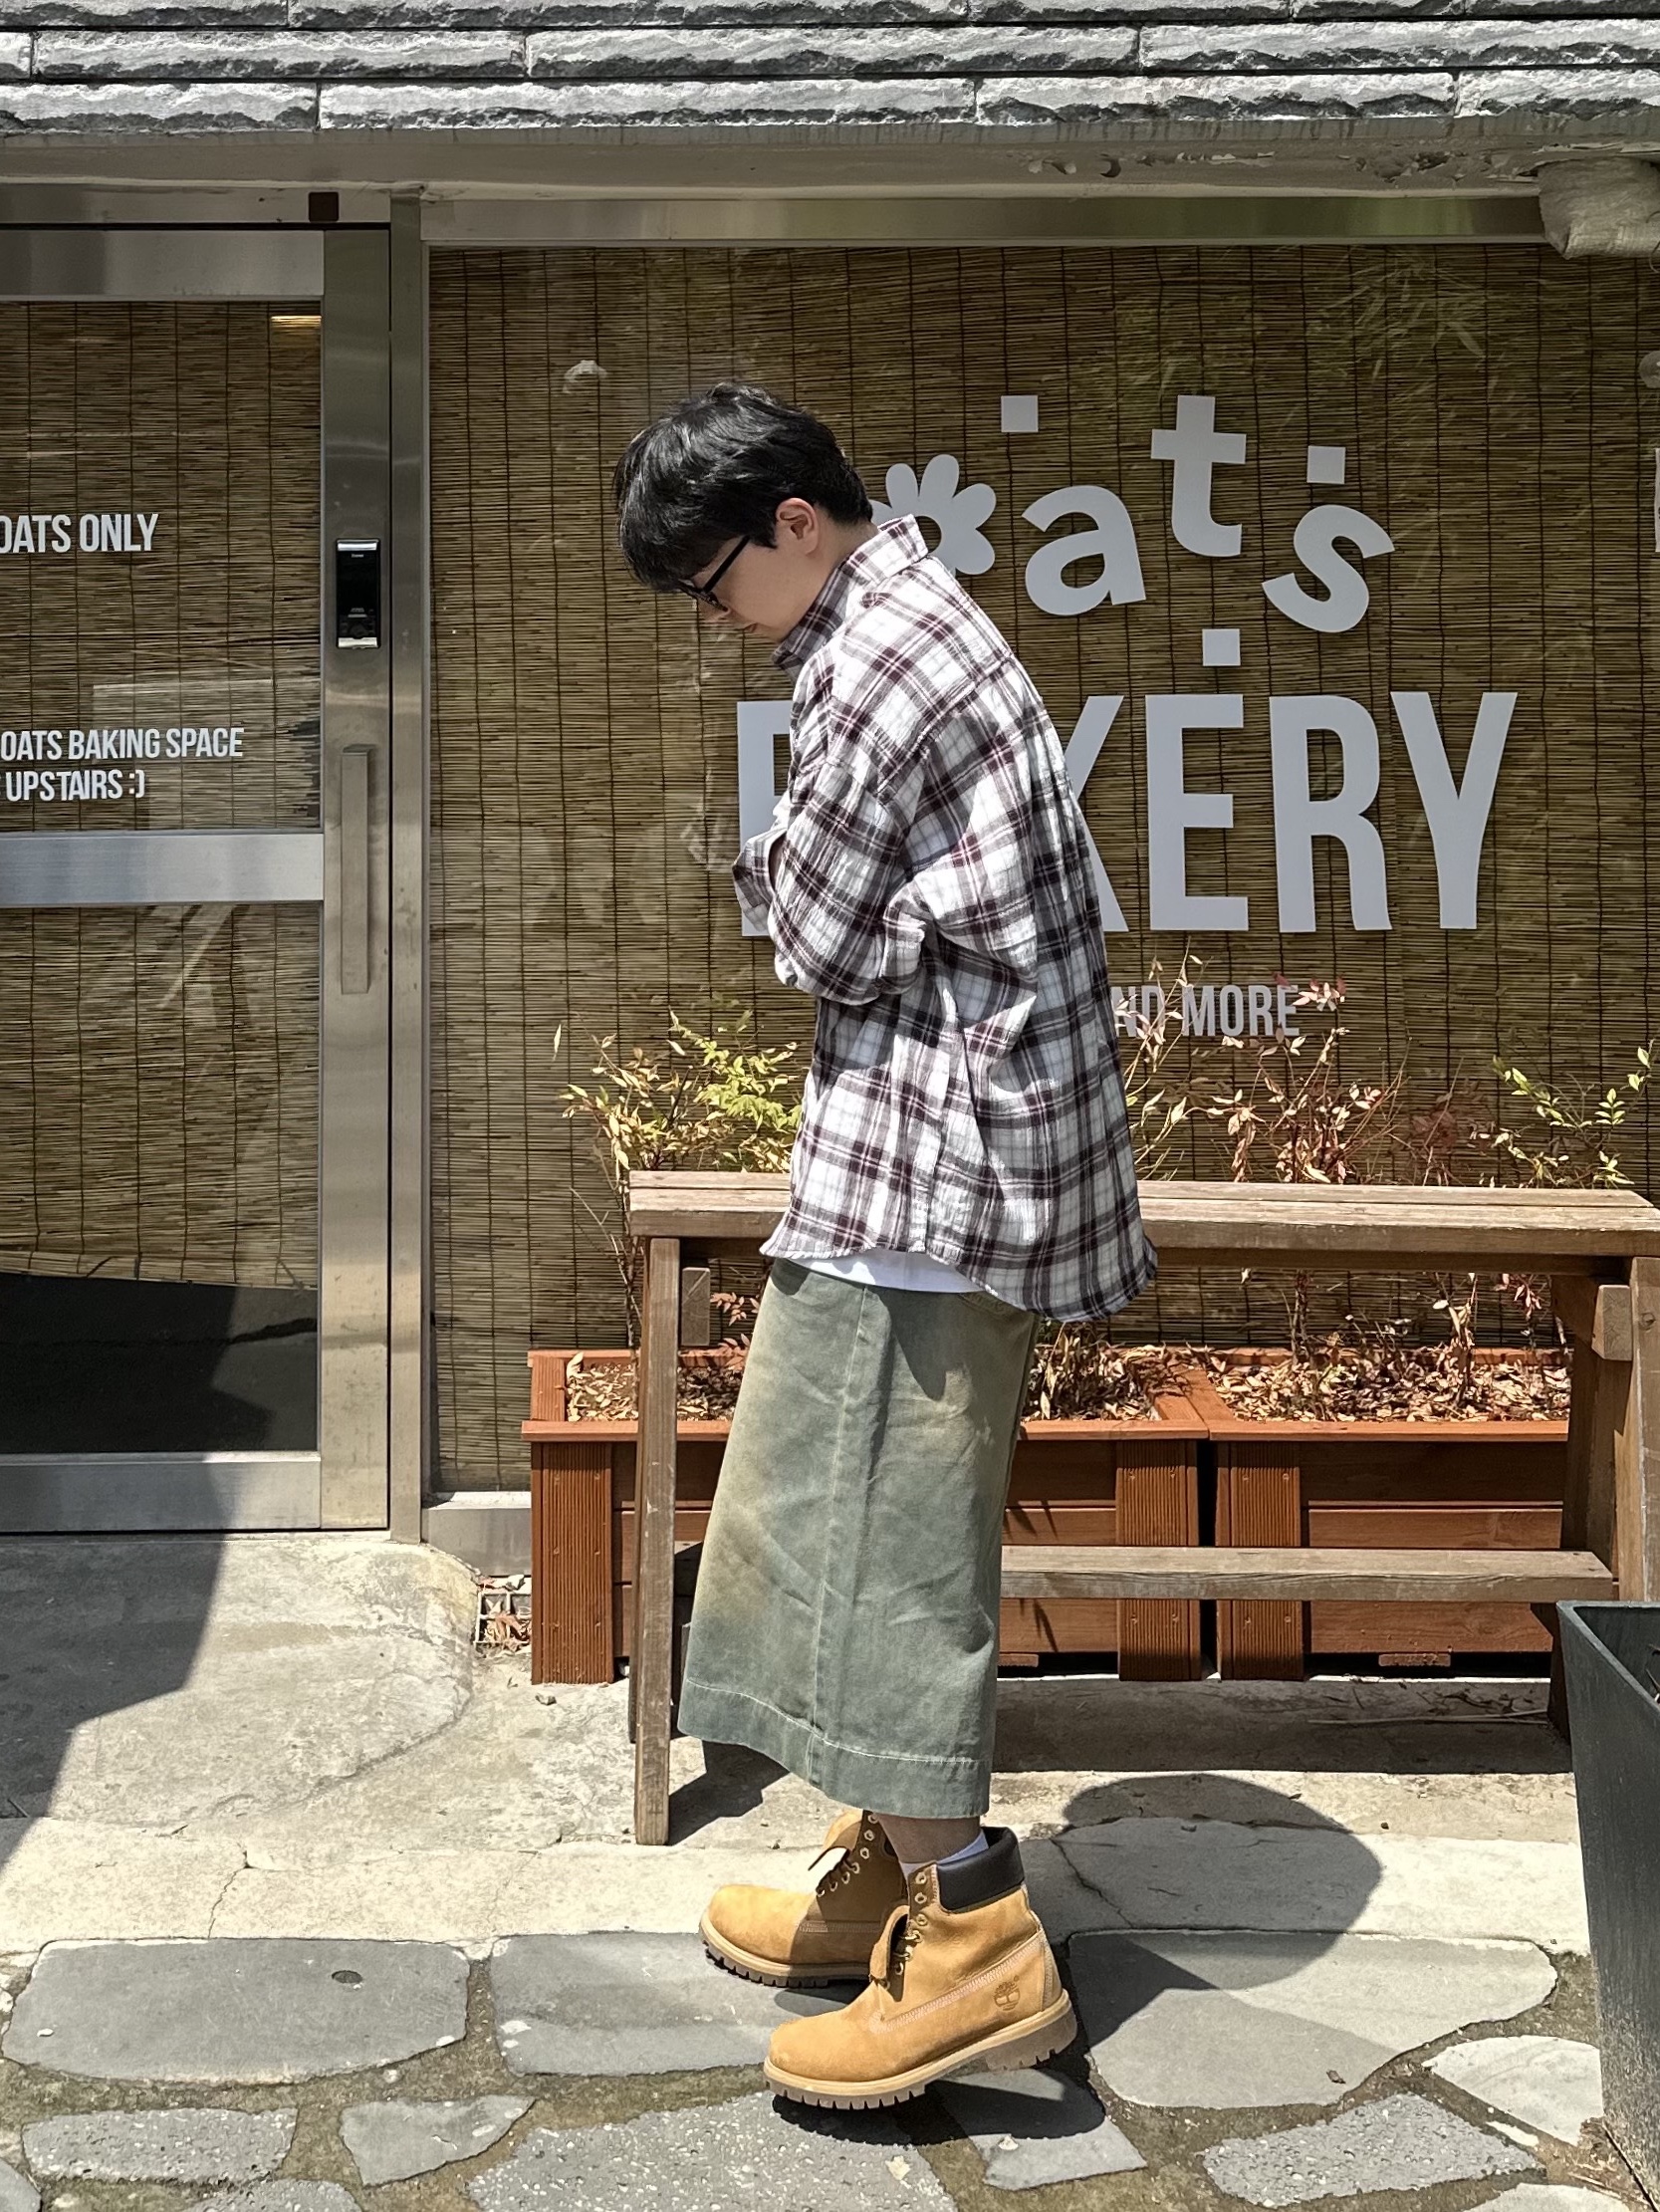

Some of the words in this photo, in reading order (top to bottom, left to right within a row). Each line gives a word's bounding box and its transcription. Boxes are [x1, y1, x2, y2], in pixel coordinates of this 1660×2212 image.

[80, 513, 159, 552] ONLY
[0, 730, 62, 761] OATS
[69, 728, 160, 759] BAKING
[166, 727, 245, 757] SPACE
[5, 770, 123, 801] UPSTAIRS
[1110, 986, 1167, 1038] ND
[1182, 984, 1301, 1037] MORE
